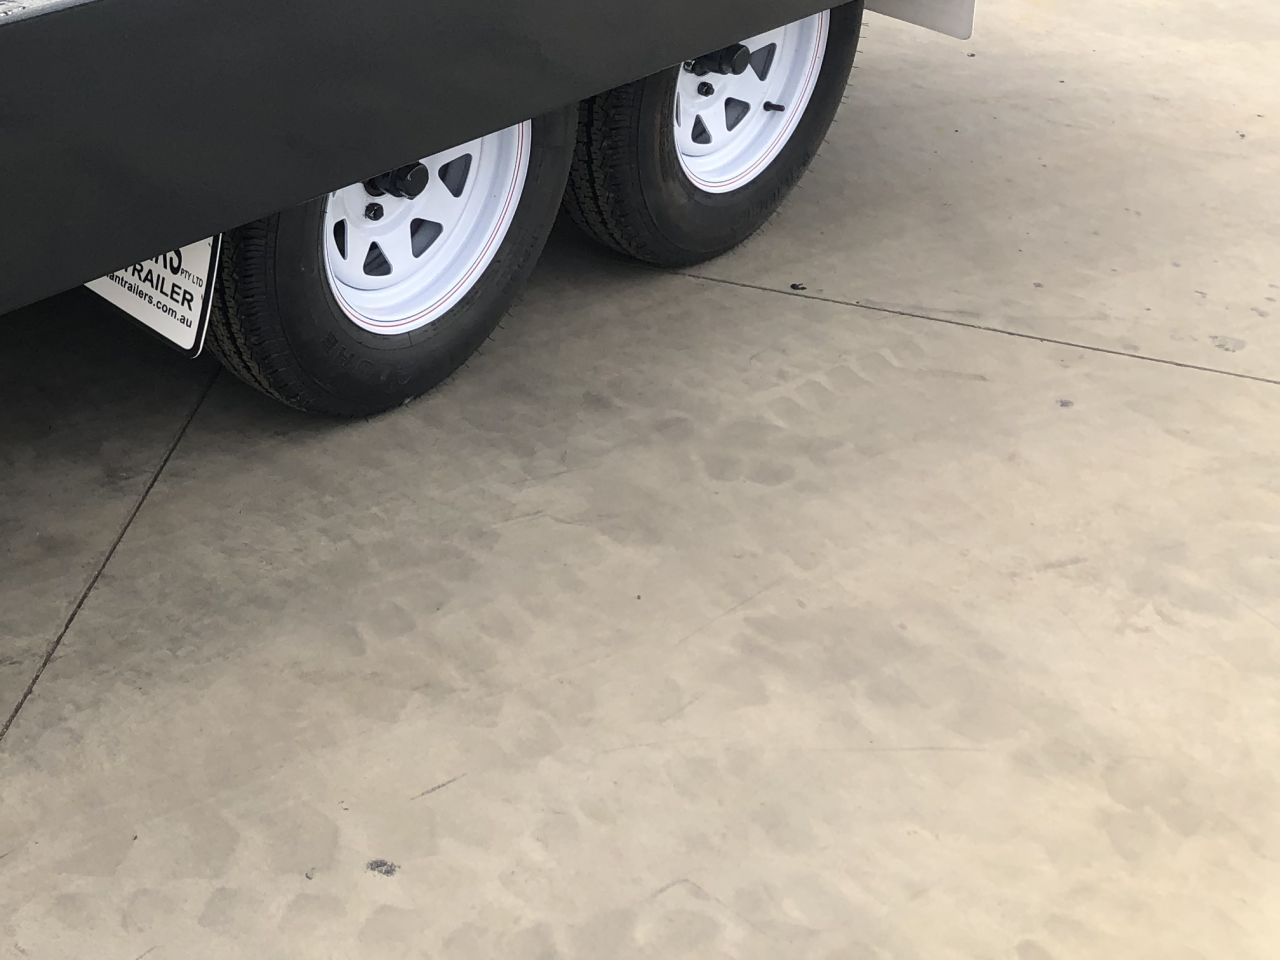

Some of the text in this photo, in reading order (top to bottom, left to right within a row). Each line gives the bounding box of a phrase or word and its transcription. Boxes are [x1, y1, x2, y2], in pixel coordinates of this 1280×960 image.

[106, 273, 192, 328] antrailers.com.au
[125, 263, 194, 311] RAILER
[180, 267, 204, 288] PTY LTD
